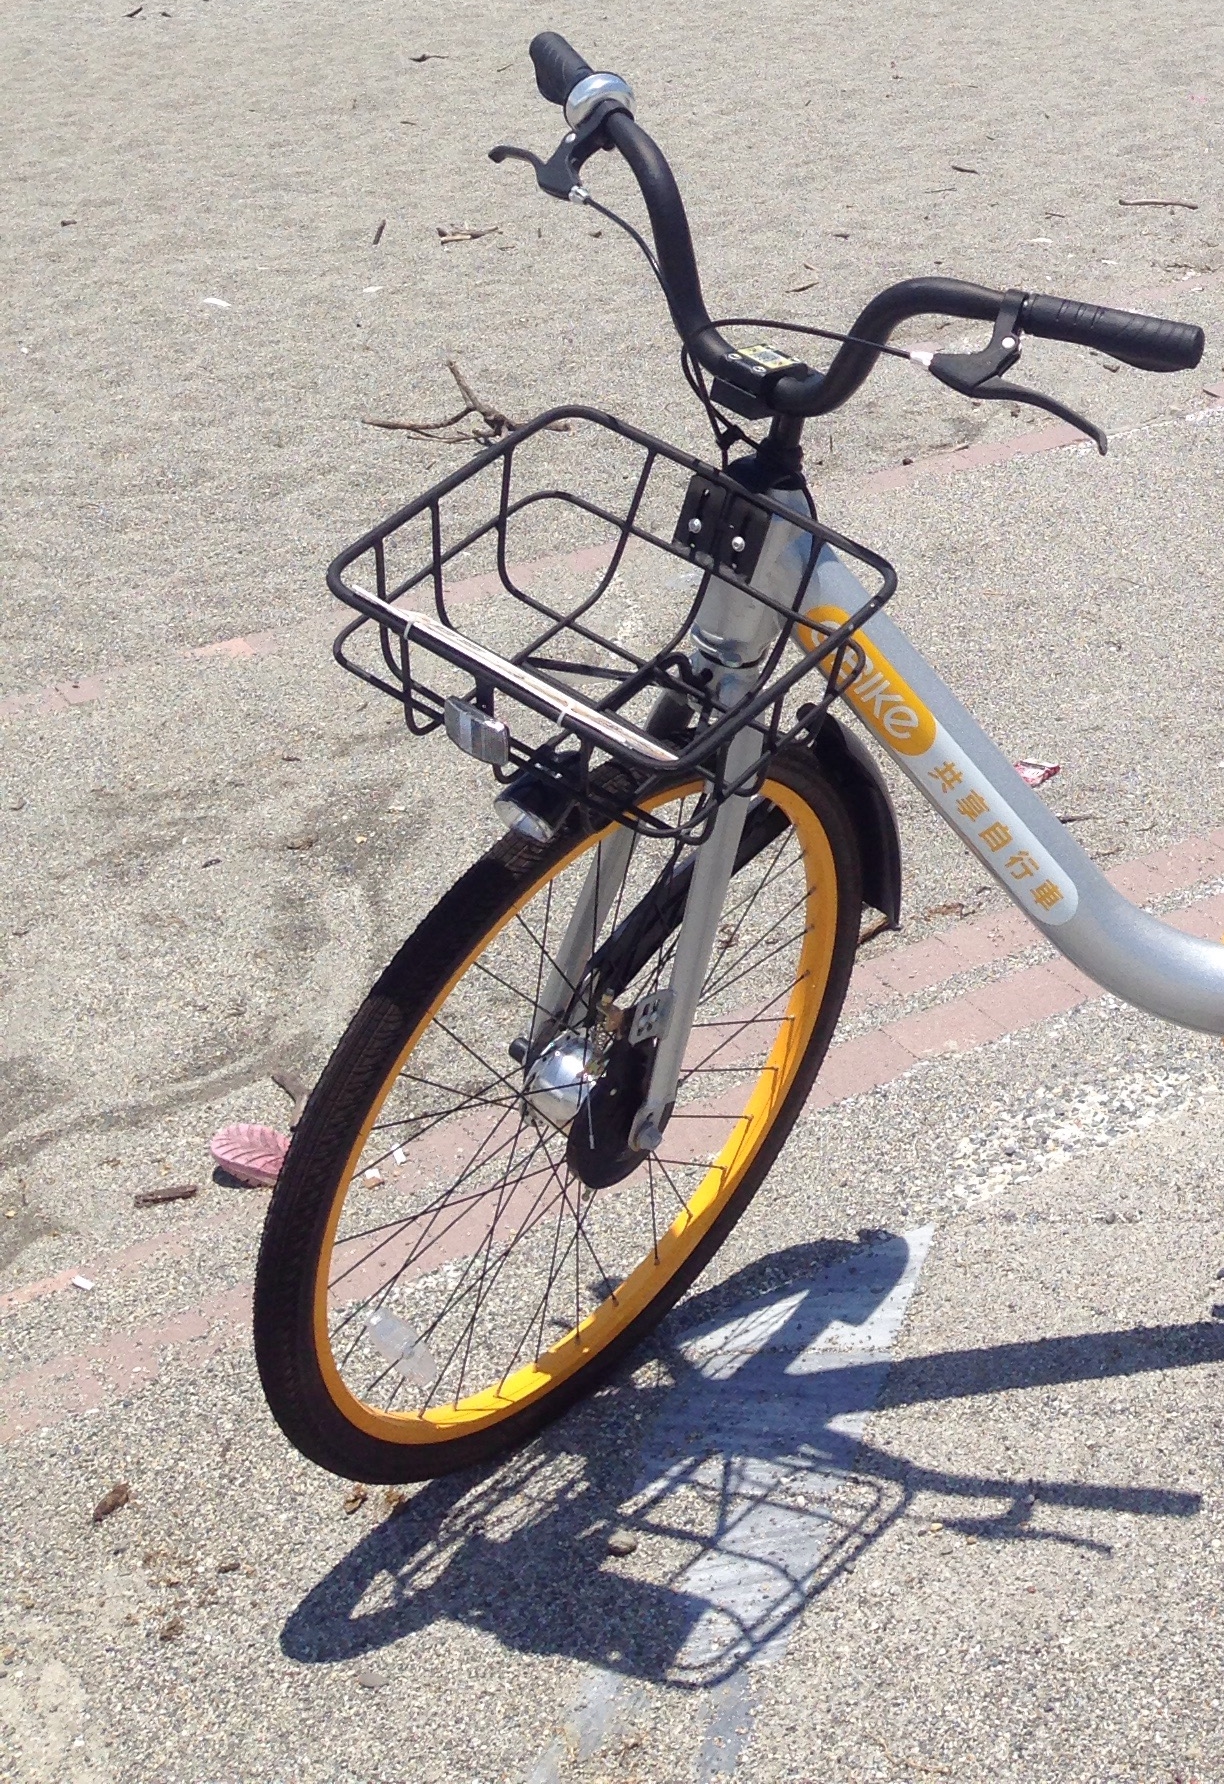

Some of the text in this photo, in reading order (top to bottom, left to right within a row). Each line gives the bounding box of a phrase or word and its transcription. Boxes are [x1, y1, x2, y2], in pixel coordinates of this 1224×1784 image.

[927, 761, 1064, 912] 共享自行車
